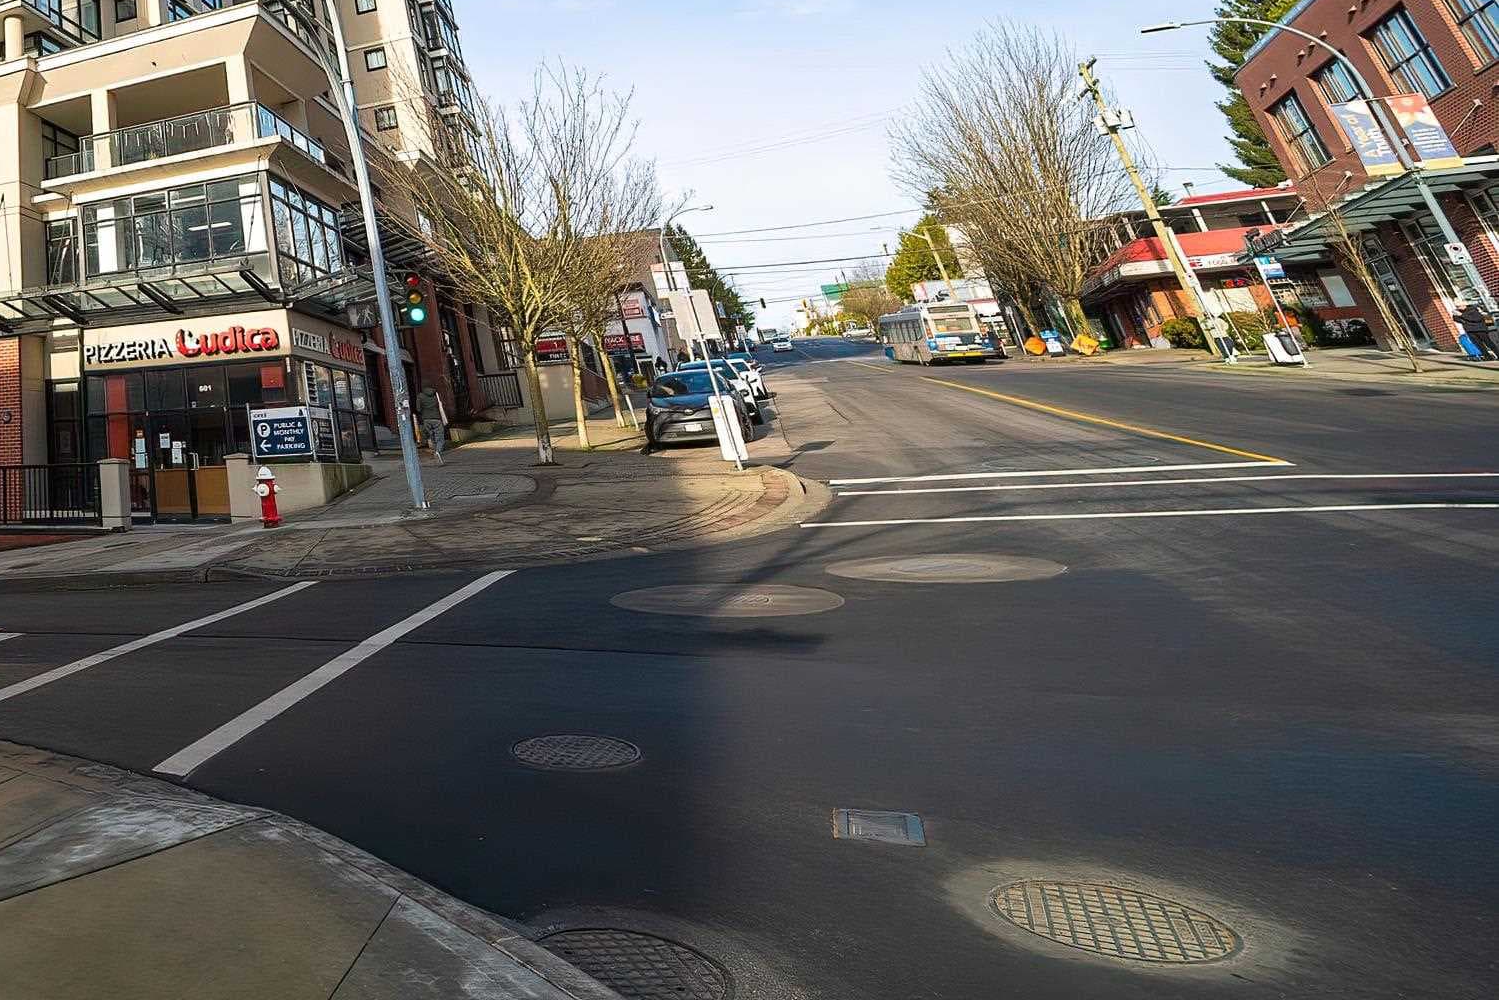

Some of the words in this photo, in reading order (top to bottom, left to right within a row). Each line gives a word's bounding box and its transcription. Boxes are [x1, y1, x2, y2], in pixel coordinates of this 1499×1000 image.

[85, 338, 172, 363] PIZZERIA
[175, 325, 279, 358] Ludica
[273, 421, 296, 429] PUBLIC
